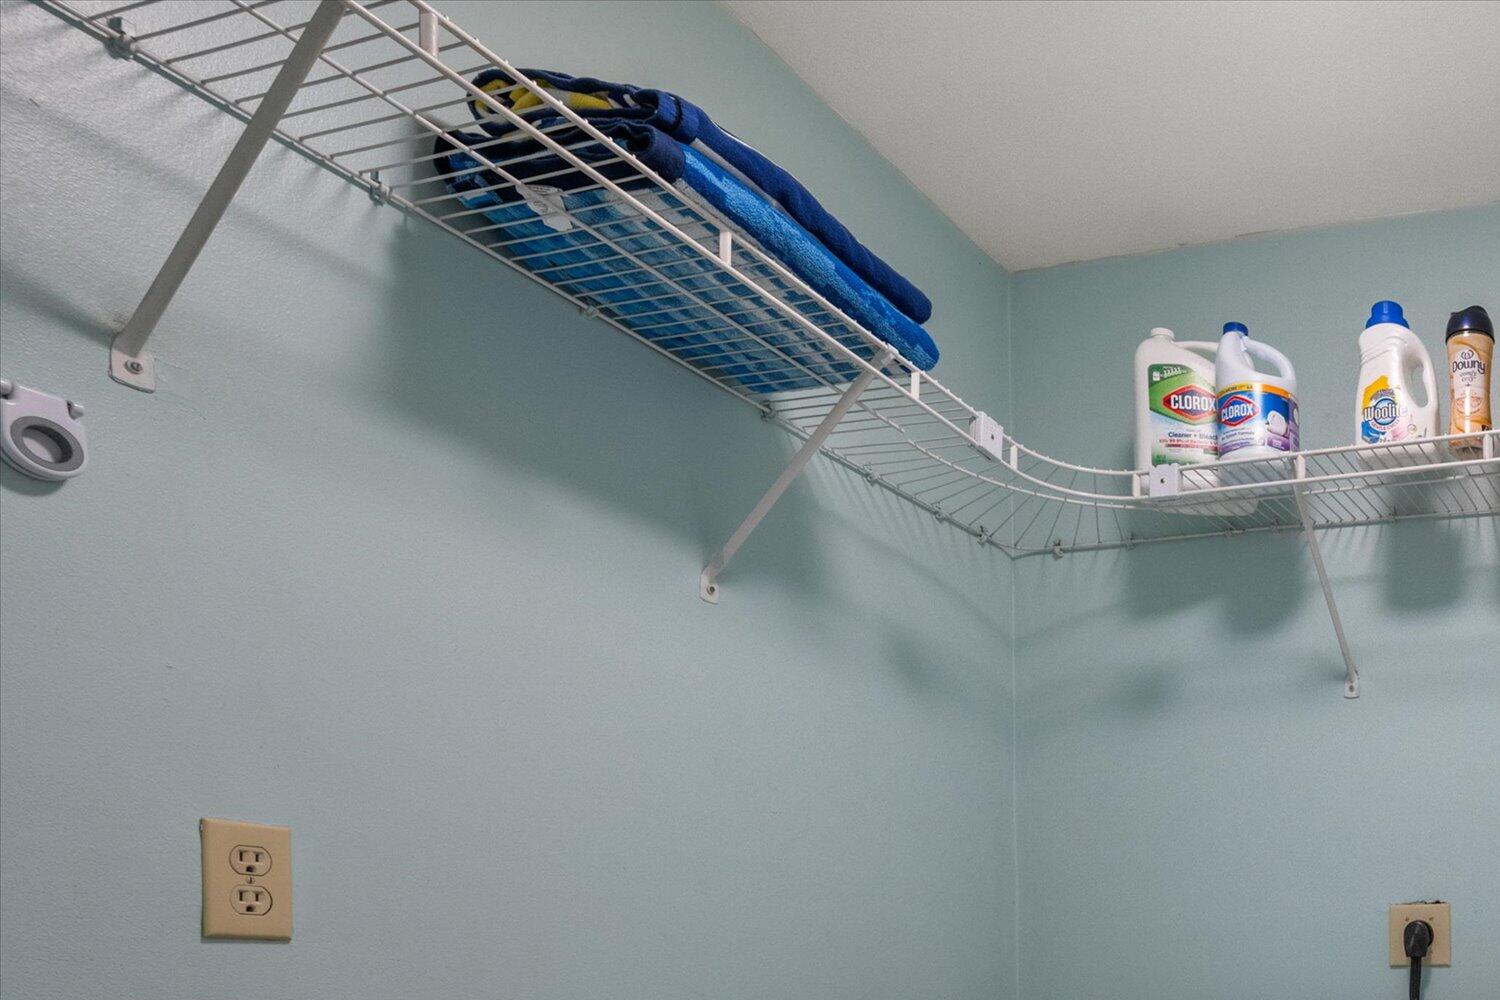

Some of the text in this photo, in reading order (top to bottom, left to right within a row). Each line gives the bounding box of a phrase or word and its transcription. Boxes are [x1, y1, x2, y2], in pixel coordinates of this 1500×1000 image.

[1452, 360, 1486, 375] Downy
[1170, 393, 1217, 412] CLOROX
[1221, 403, 1254, 420] CLOROX
[1363, 403, 1408, 421] Woolite
